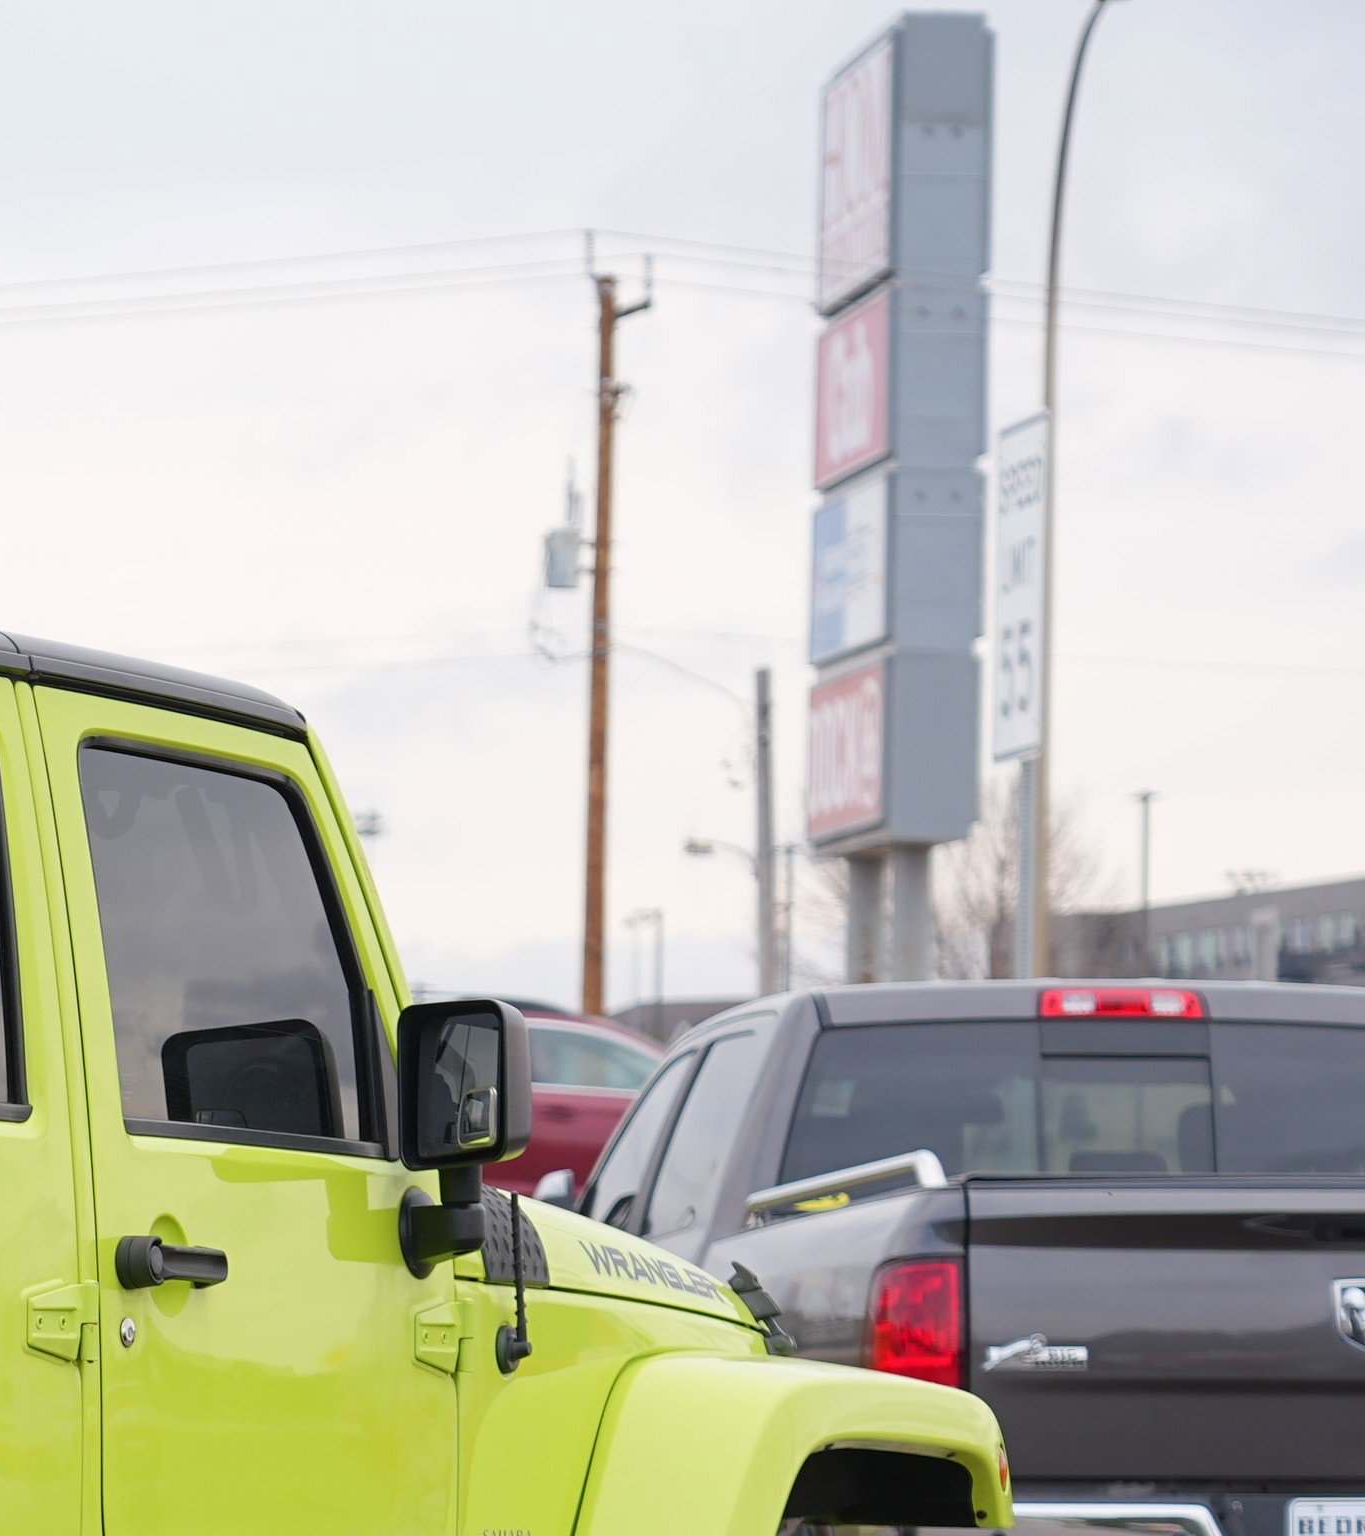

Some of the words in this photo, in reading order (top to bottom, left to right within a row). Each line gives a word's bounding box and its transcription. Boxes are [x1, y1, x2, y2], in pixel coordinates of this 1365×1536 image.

[999, 455, 1042, 517] SPEED
[1000, 534, 1036, 594] LIMIT
[999, 619, 1031, 718] 55
[577, 1239, 726, 1304] WRANGLER
